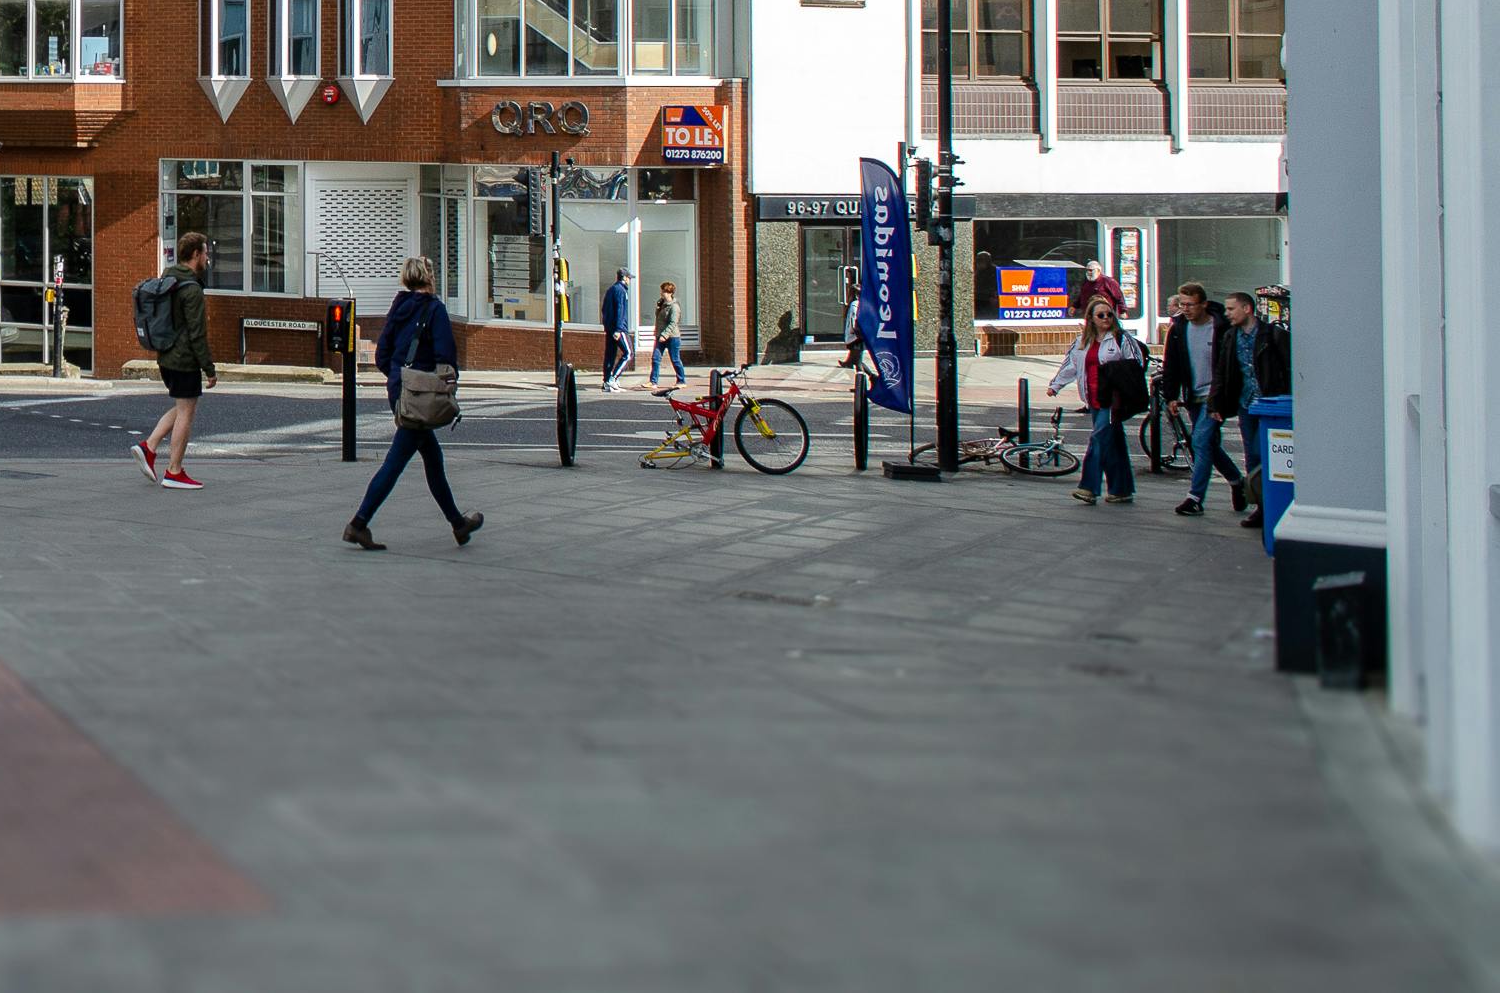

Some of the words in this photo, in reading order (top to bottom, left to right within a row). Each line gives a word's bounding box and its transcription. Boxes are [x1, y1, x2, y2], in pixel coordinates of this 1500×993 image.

[492, 100, 591, 137] QRQ
[712, 118, 723, 131] LET
[665, 127, 691, 145] TO
[665, 149, 690, 159] 01273
[691, 150, 722, 160] 876200
[786, 201, 829, 214] 96-97
[835, 200, 862, 215] QU
[1011, 284, 1029, 292] SHW
[1015, 296, 1031, 307] TO
[1033, 296, 1050, 307] LET
[1003, 309, 1031, 319] 01273
[1031, 309, 1063, 319] 876200
[245, 320, 287, 328] GLOUCESTER
[1271, 444, 1294, 455] CARD
